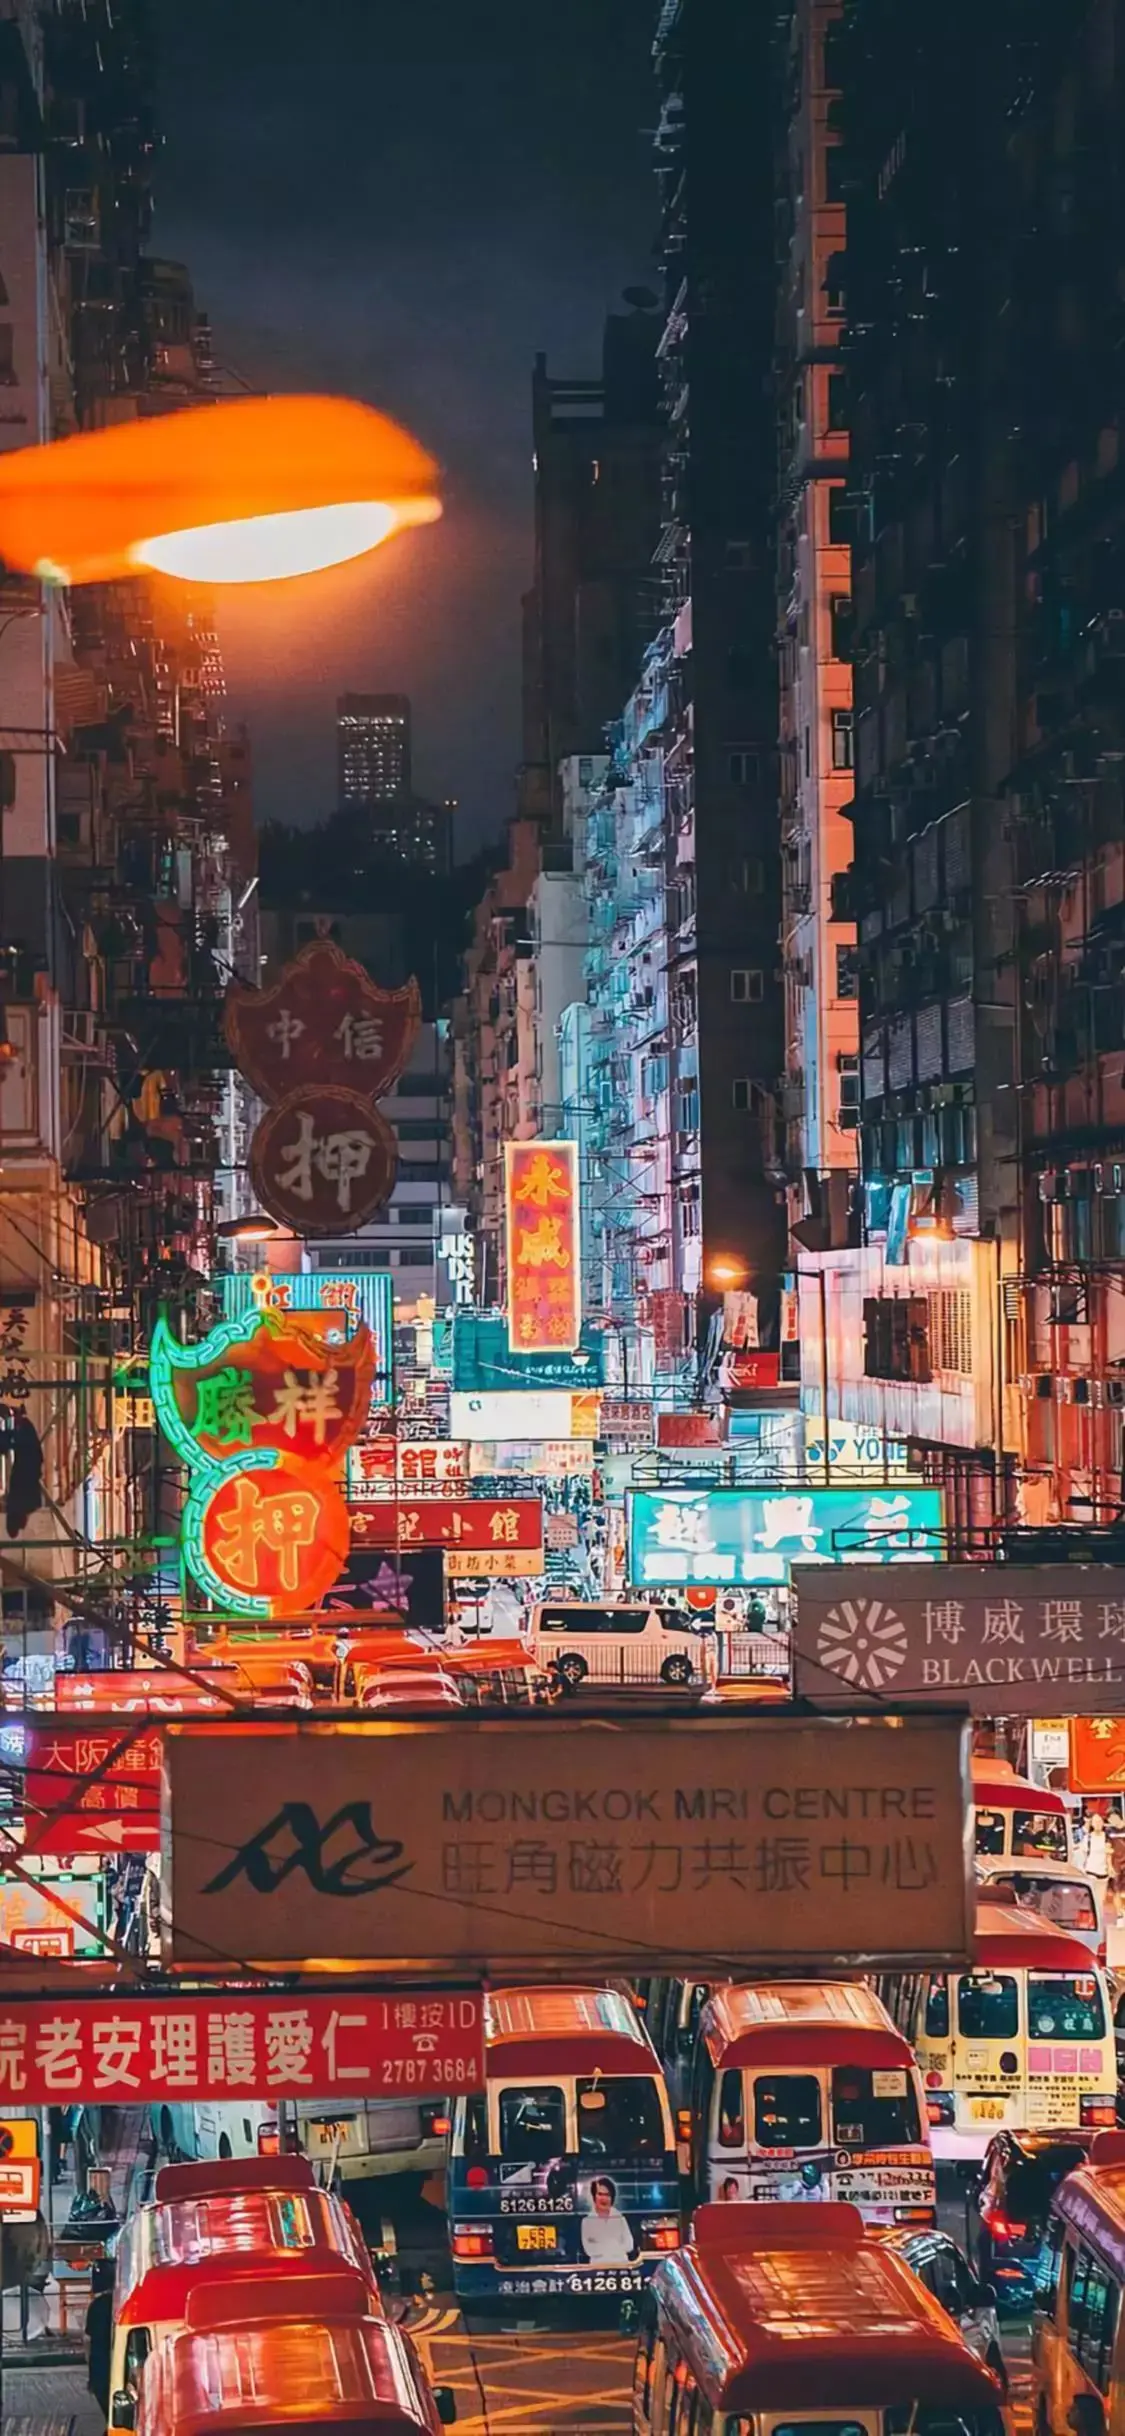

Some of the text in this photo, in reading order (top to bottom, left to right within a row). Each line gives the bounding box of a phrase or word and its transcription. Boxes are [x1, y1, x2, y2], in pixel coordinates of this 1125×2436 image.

[273, 1110, 377, 1213] 押
[211, 1476, 320, 1591] 押
[922, 1656, 1123, 1685] BLACKWELL
[442, 1787, 936, 1823] MONGKOK MRI CENTRE
[442, 1836, 939, 1895] 旺角磁力共振中心
[381, 2056, 478, 2085] 2787 3684
[570, 2277, 617, 2292] 8126
